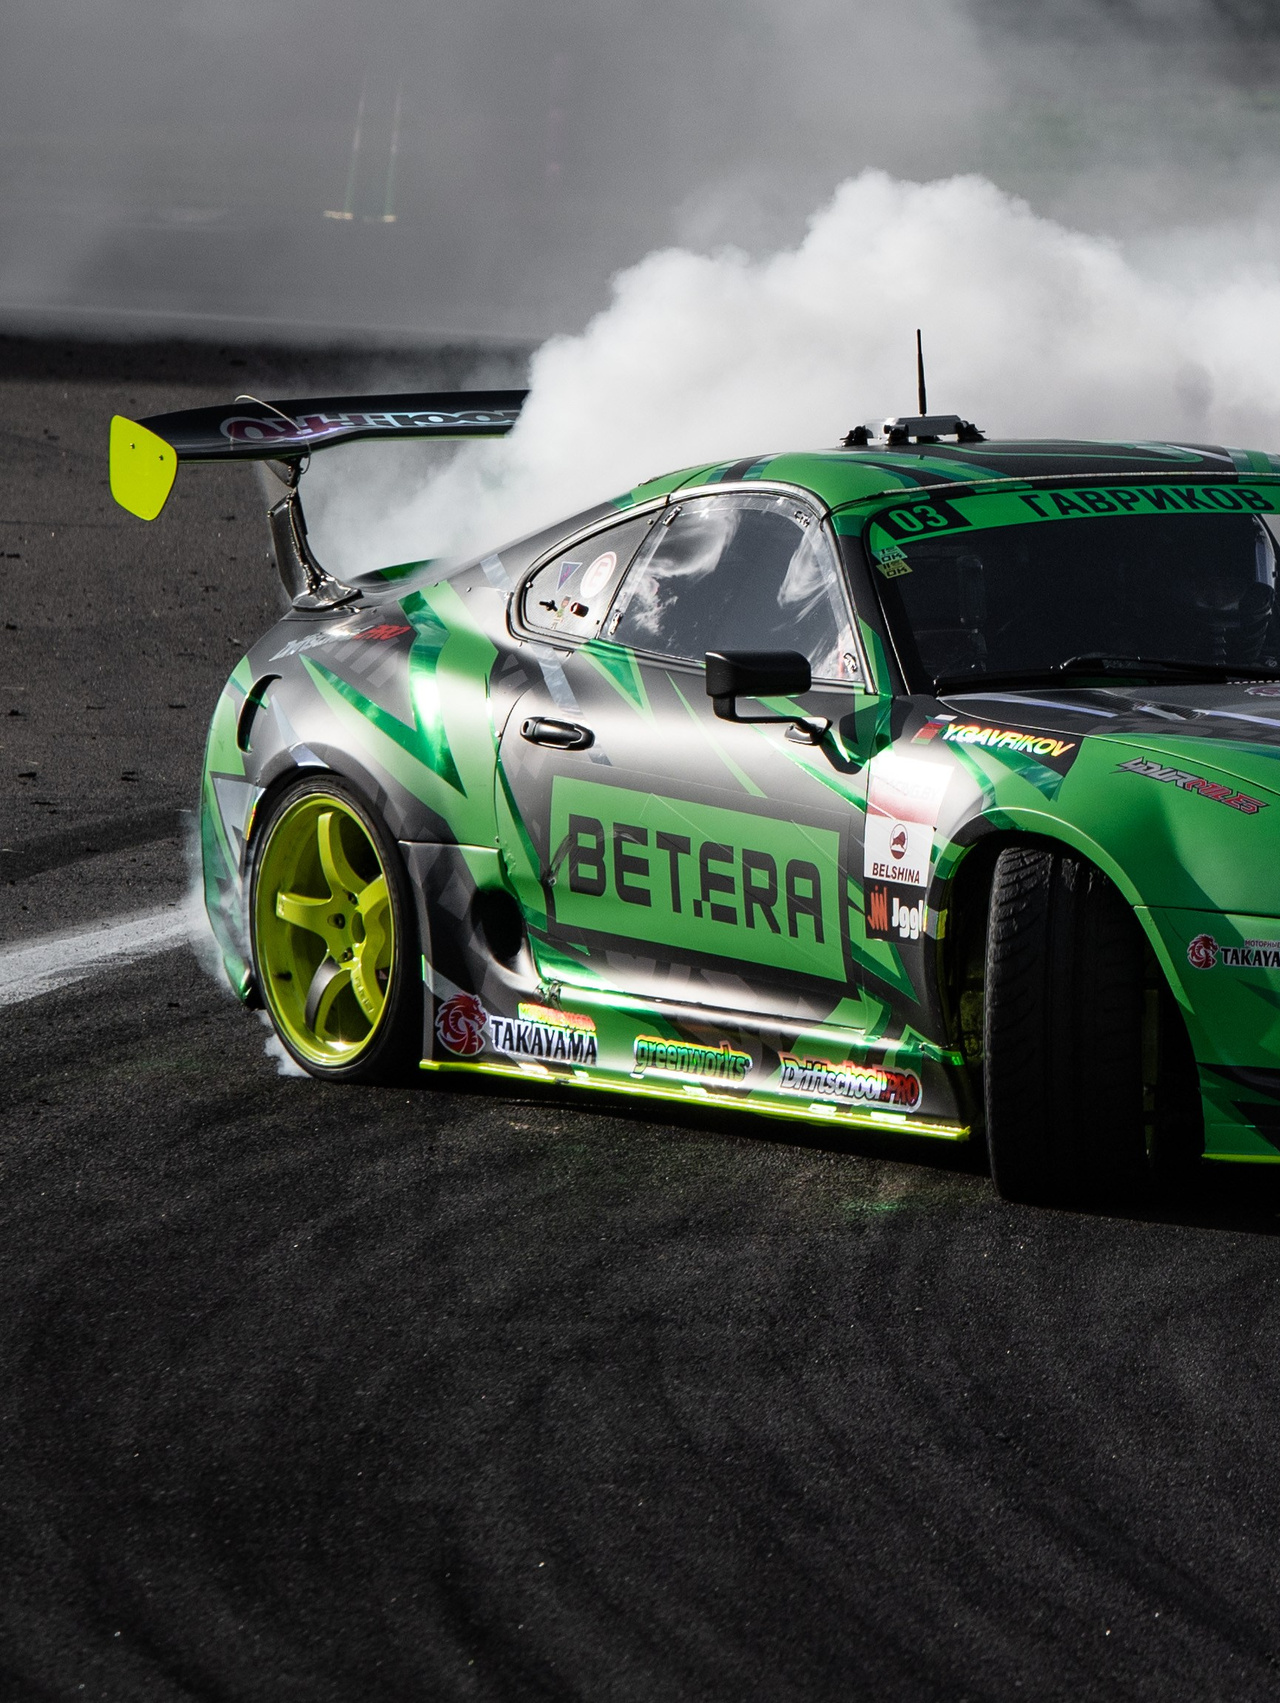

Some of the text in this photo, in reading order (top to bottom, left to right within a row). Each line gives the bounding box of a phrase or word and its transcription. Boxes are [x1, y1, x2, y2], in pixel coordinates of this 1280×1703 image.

[1018, 488, 1275, 518] ГАВРИКОВ
[888, 505, 949, 532] 03
[942, 724, 1075, 757] Y.GAVRIKOV
[872, 862, 920, 884] BELSHINA
[1245, 940, 1280, 949] МОТОРНЫЕ
[491, 1019, 597, 1066] TAKAYAMA
[632, 1039, 747, 1082] greenworks
